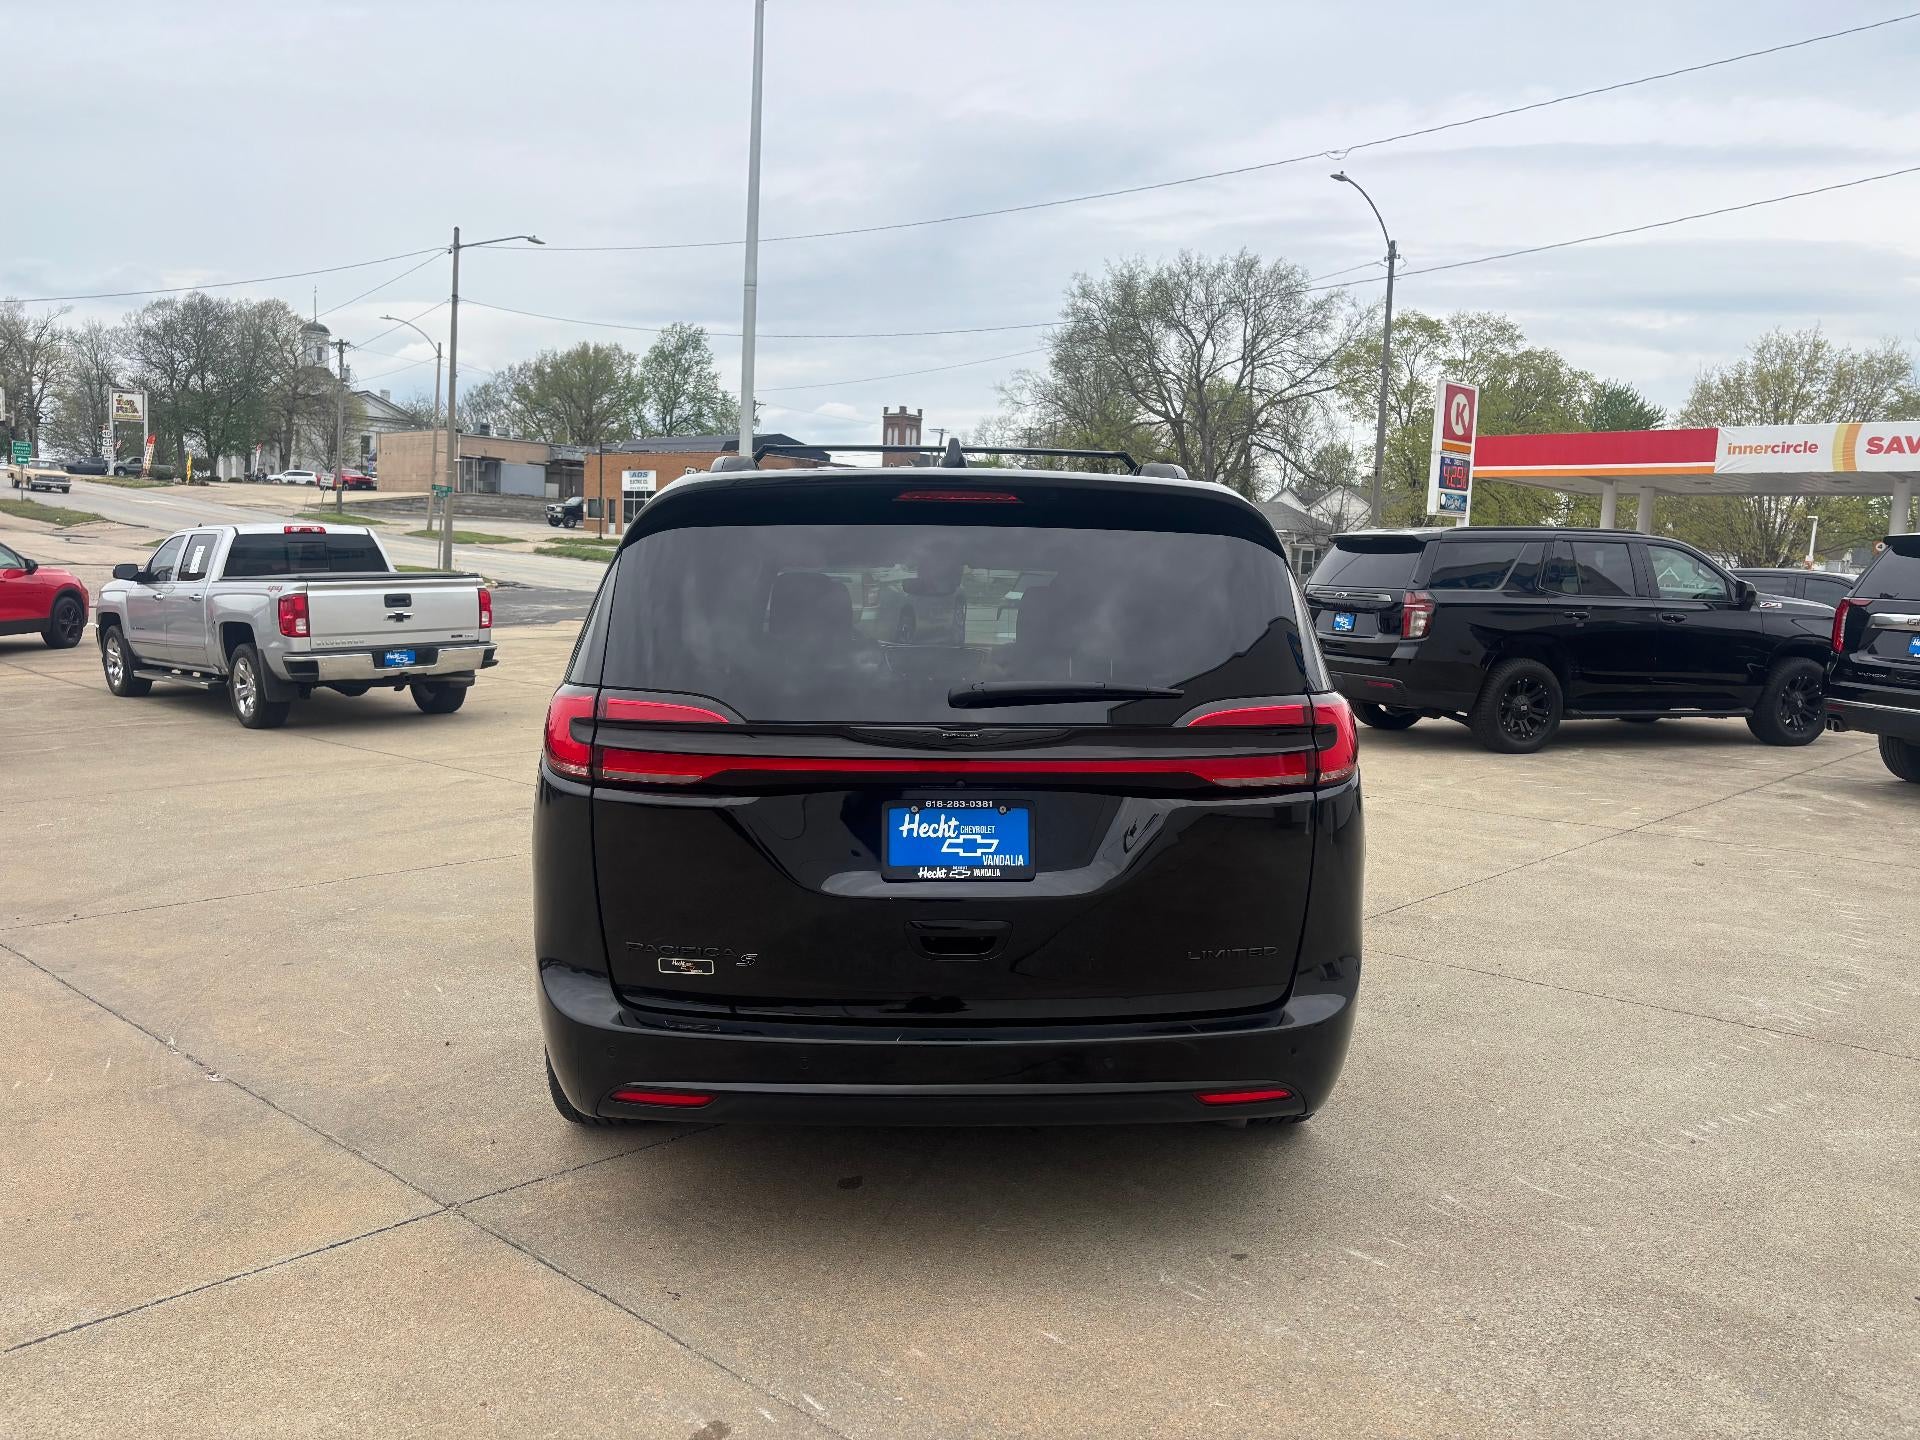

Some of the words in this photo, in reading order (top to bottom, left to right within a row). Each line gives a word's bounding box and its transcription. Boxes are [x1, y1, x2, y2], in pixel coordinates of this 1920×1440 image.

[1455, 402, 1468, 431] K
[1727, 440, 1819, 456] innercircle
[925, 800, 993, 808] 618-283-0381
[899, 814, 960, 838] Hecht
[960, 825, 995, 834] CHEVROLET
[983, 854, 1024, 866] VANDALIA
[917, 866, 947, 879] Hecht
[973, 868, 1001, 877] VANDALIA
[625, 941, 738, 958] PACIFICA
[1187, 946, 1280, 960] LIMITED
